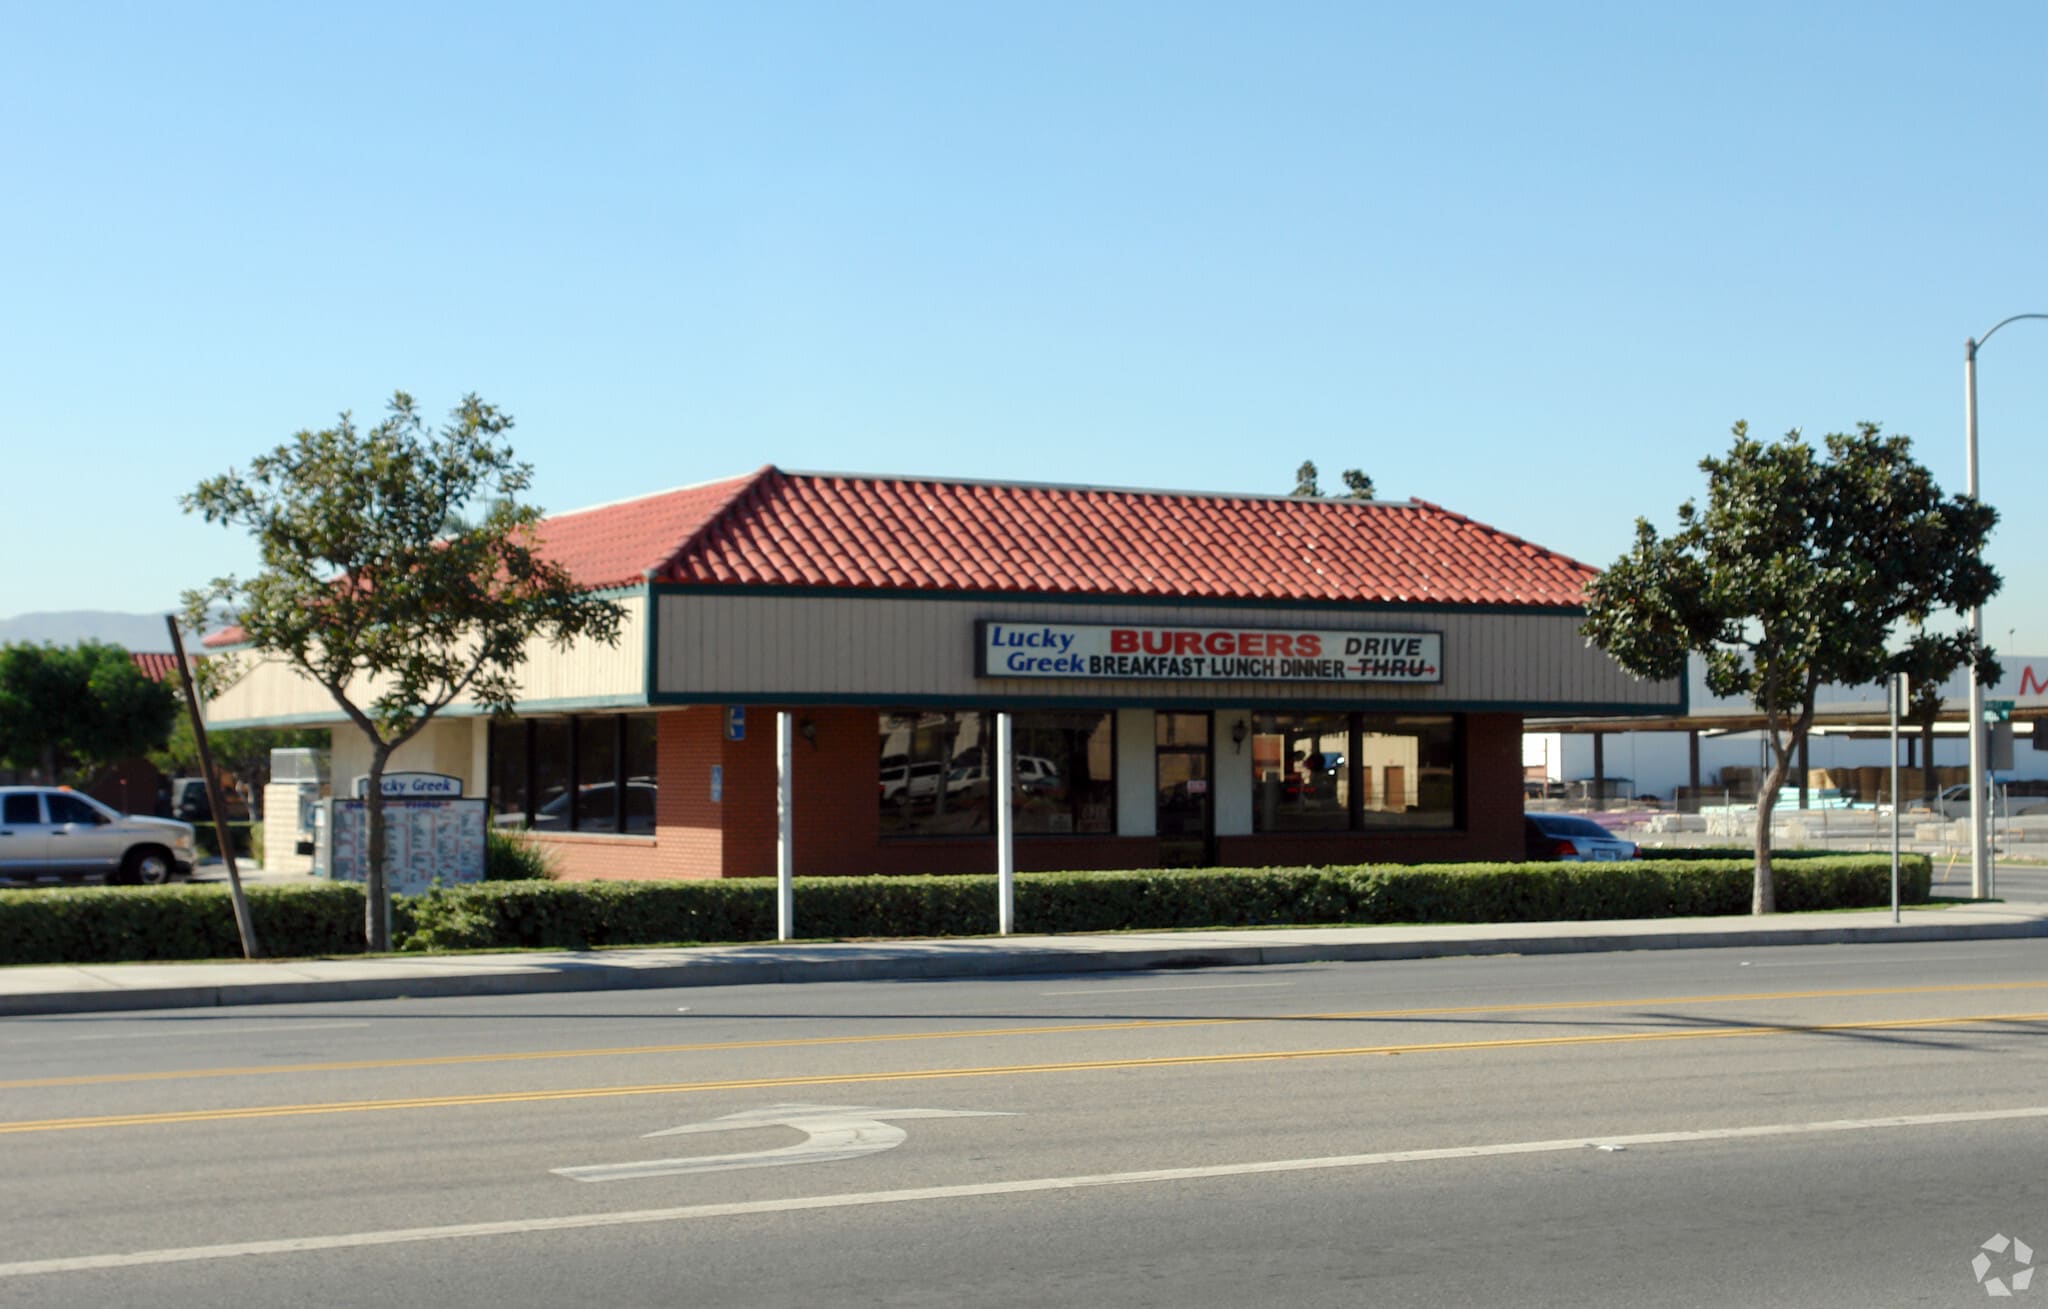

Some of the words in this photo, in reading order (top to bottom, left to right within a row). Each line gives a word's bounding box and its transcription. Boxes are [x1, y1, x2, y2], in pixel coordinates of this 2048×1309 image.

[991, 626, 1075, 653] Lucky
[1110, 629, 1322, 657] BURGERS
[1344, 637, 1423, 656] DRIVE
[1006, 651, 1085, 673] Greek
[1089, 655, 1206, 676] BREAKFAST
[1210, 657, 1274, 678] LUNCH
[1280, 659, 1346, 678] DINNER
[1357, 659, 1425, 677] THRU
[411, 777, 451, 792] Greek
